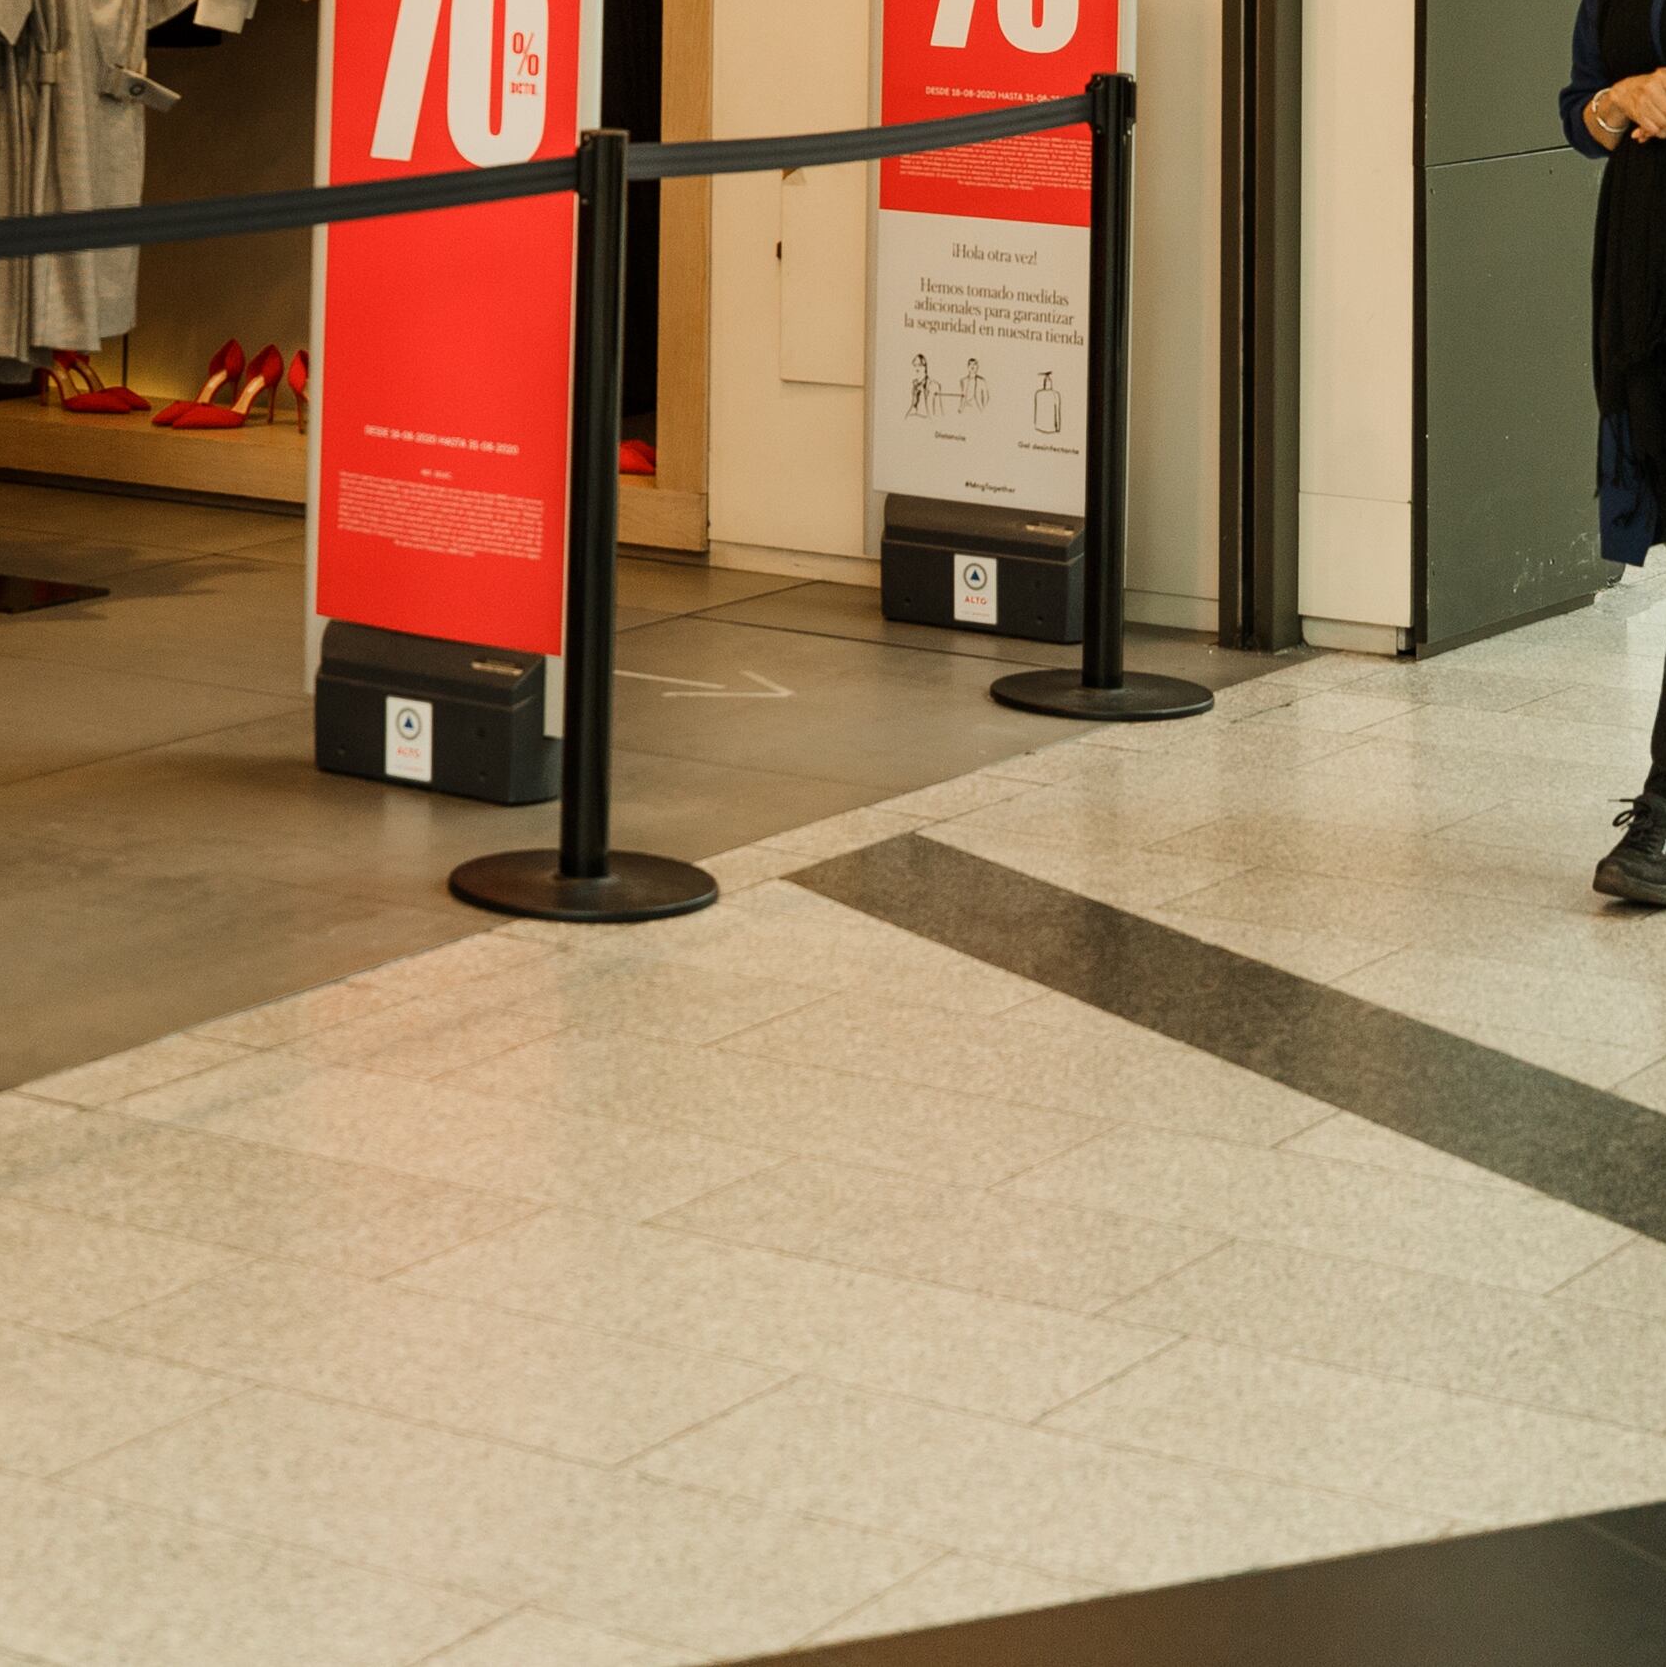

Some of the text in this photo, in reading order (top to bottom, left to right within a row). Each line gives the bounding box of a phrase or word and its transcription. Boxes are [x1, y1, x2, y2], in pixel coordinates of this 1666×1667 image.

[925, 86, 950, 95] DESDE
[998, 90, 1023, 101] HASTA
[987, 249, 1012, 263] otra
[1015, 249, 1038, 266] vez!
[920, 277, 1069, 306] Hemos tomado medidas
[914, 295, 1074, 325] adicionales para garantizar
[904, 312, 1084, 346] la seguridad en nuestra tienda
[964, 595, 987, 606] ALTO
